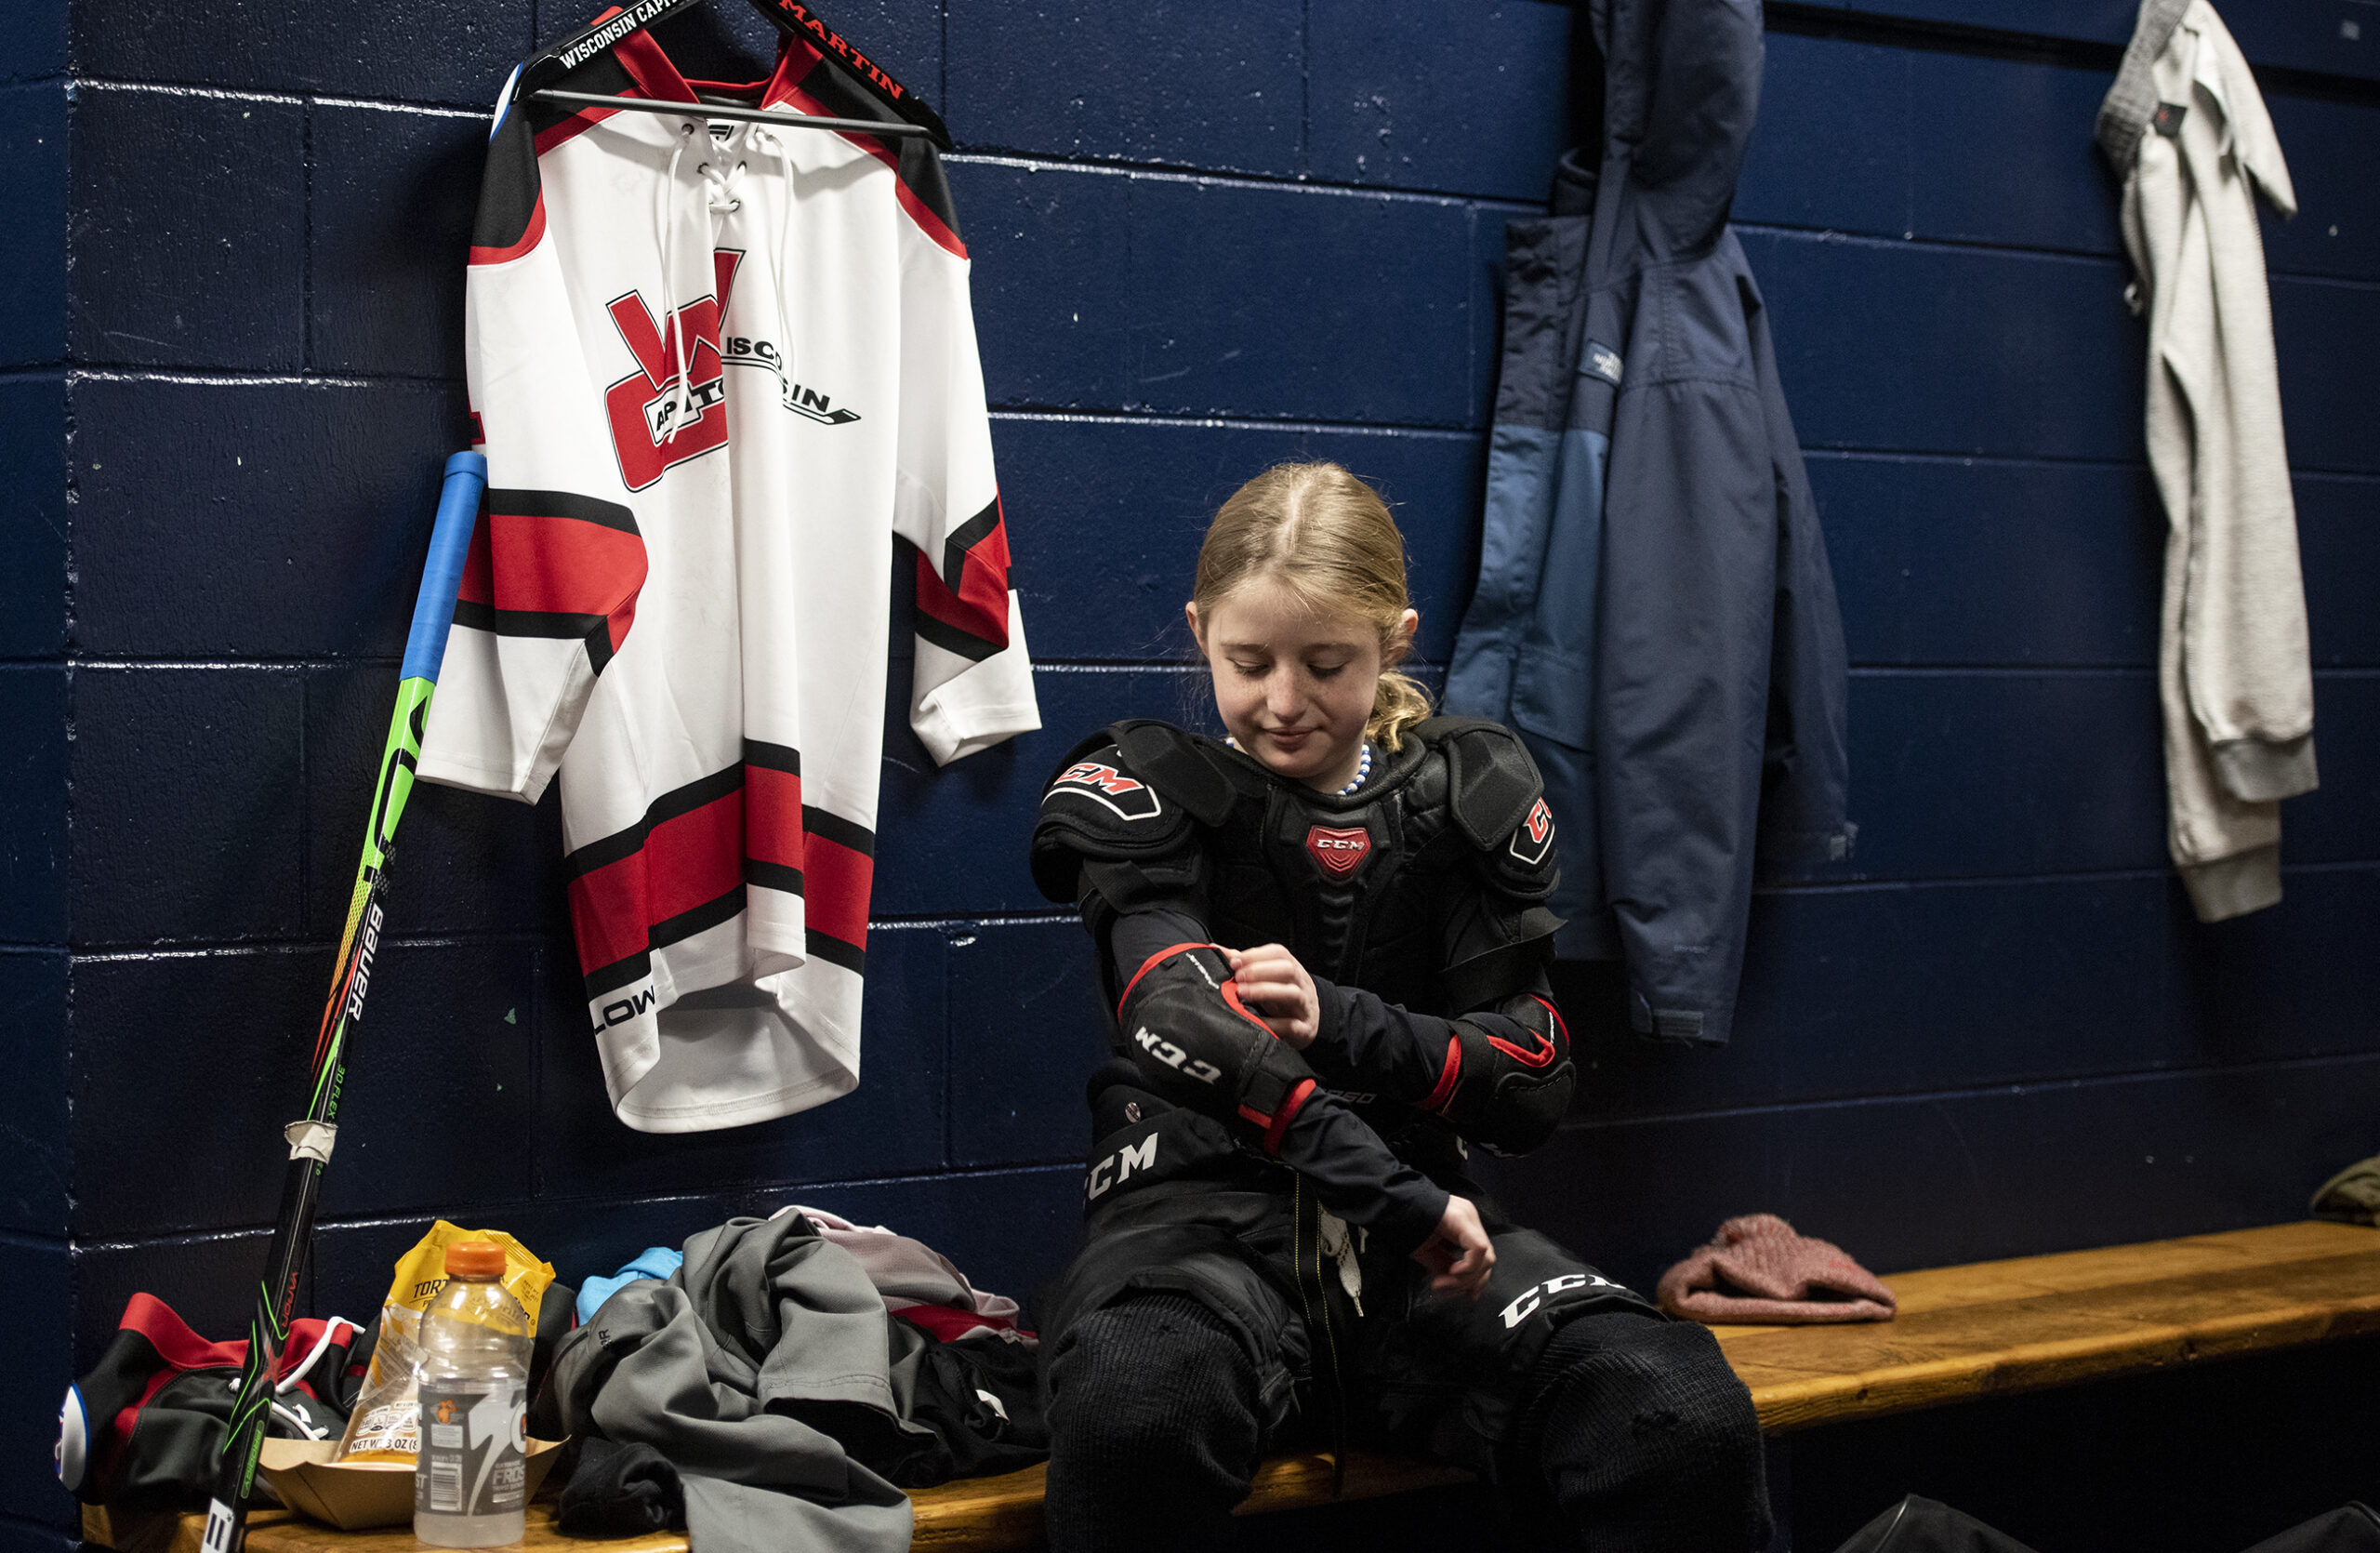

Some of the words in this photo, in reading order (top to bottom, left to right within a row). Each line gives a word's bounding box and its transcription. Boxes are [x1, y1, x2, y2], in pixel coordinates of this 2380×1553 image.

[559, 14, 637, 69] WISCONSIN
[636, 0, 677, 22] CAPI
[779, 0, 904, 100] MARTIN
[1316, 839, 1365, 851] CCM
[1135, 1026, 1222, 1085] CCM
[327, 1085, 341, 1120] FLEX
[1083, 1133, 1158, 1209] CM
[351, 1440, 368, 1451] NET
[394, 1439, 407, 1449] OZ
